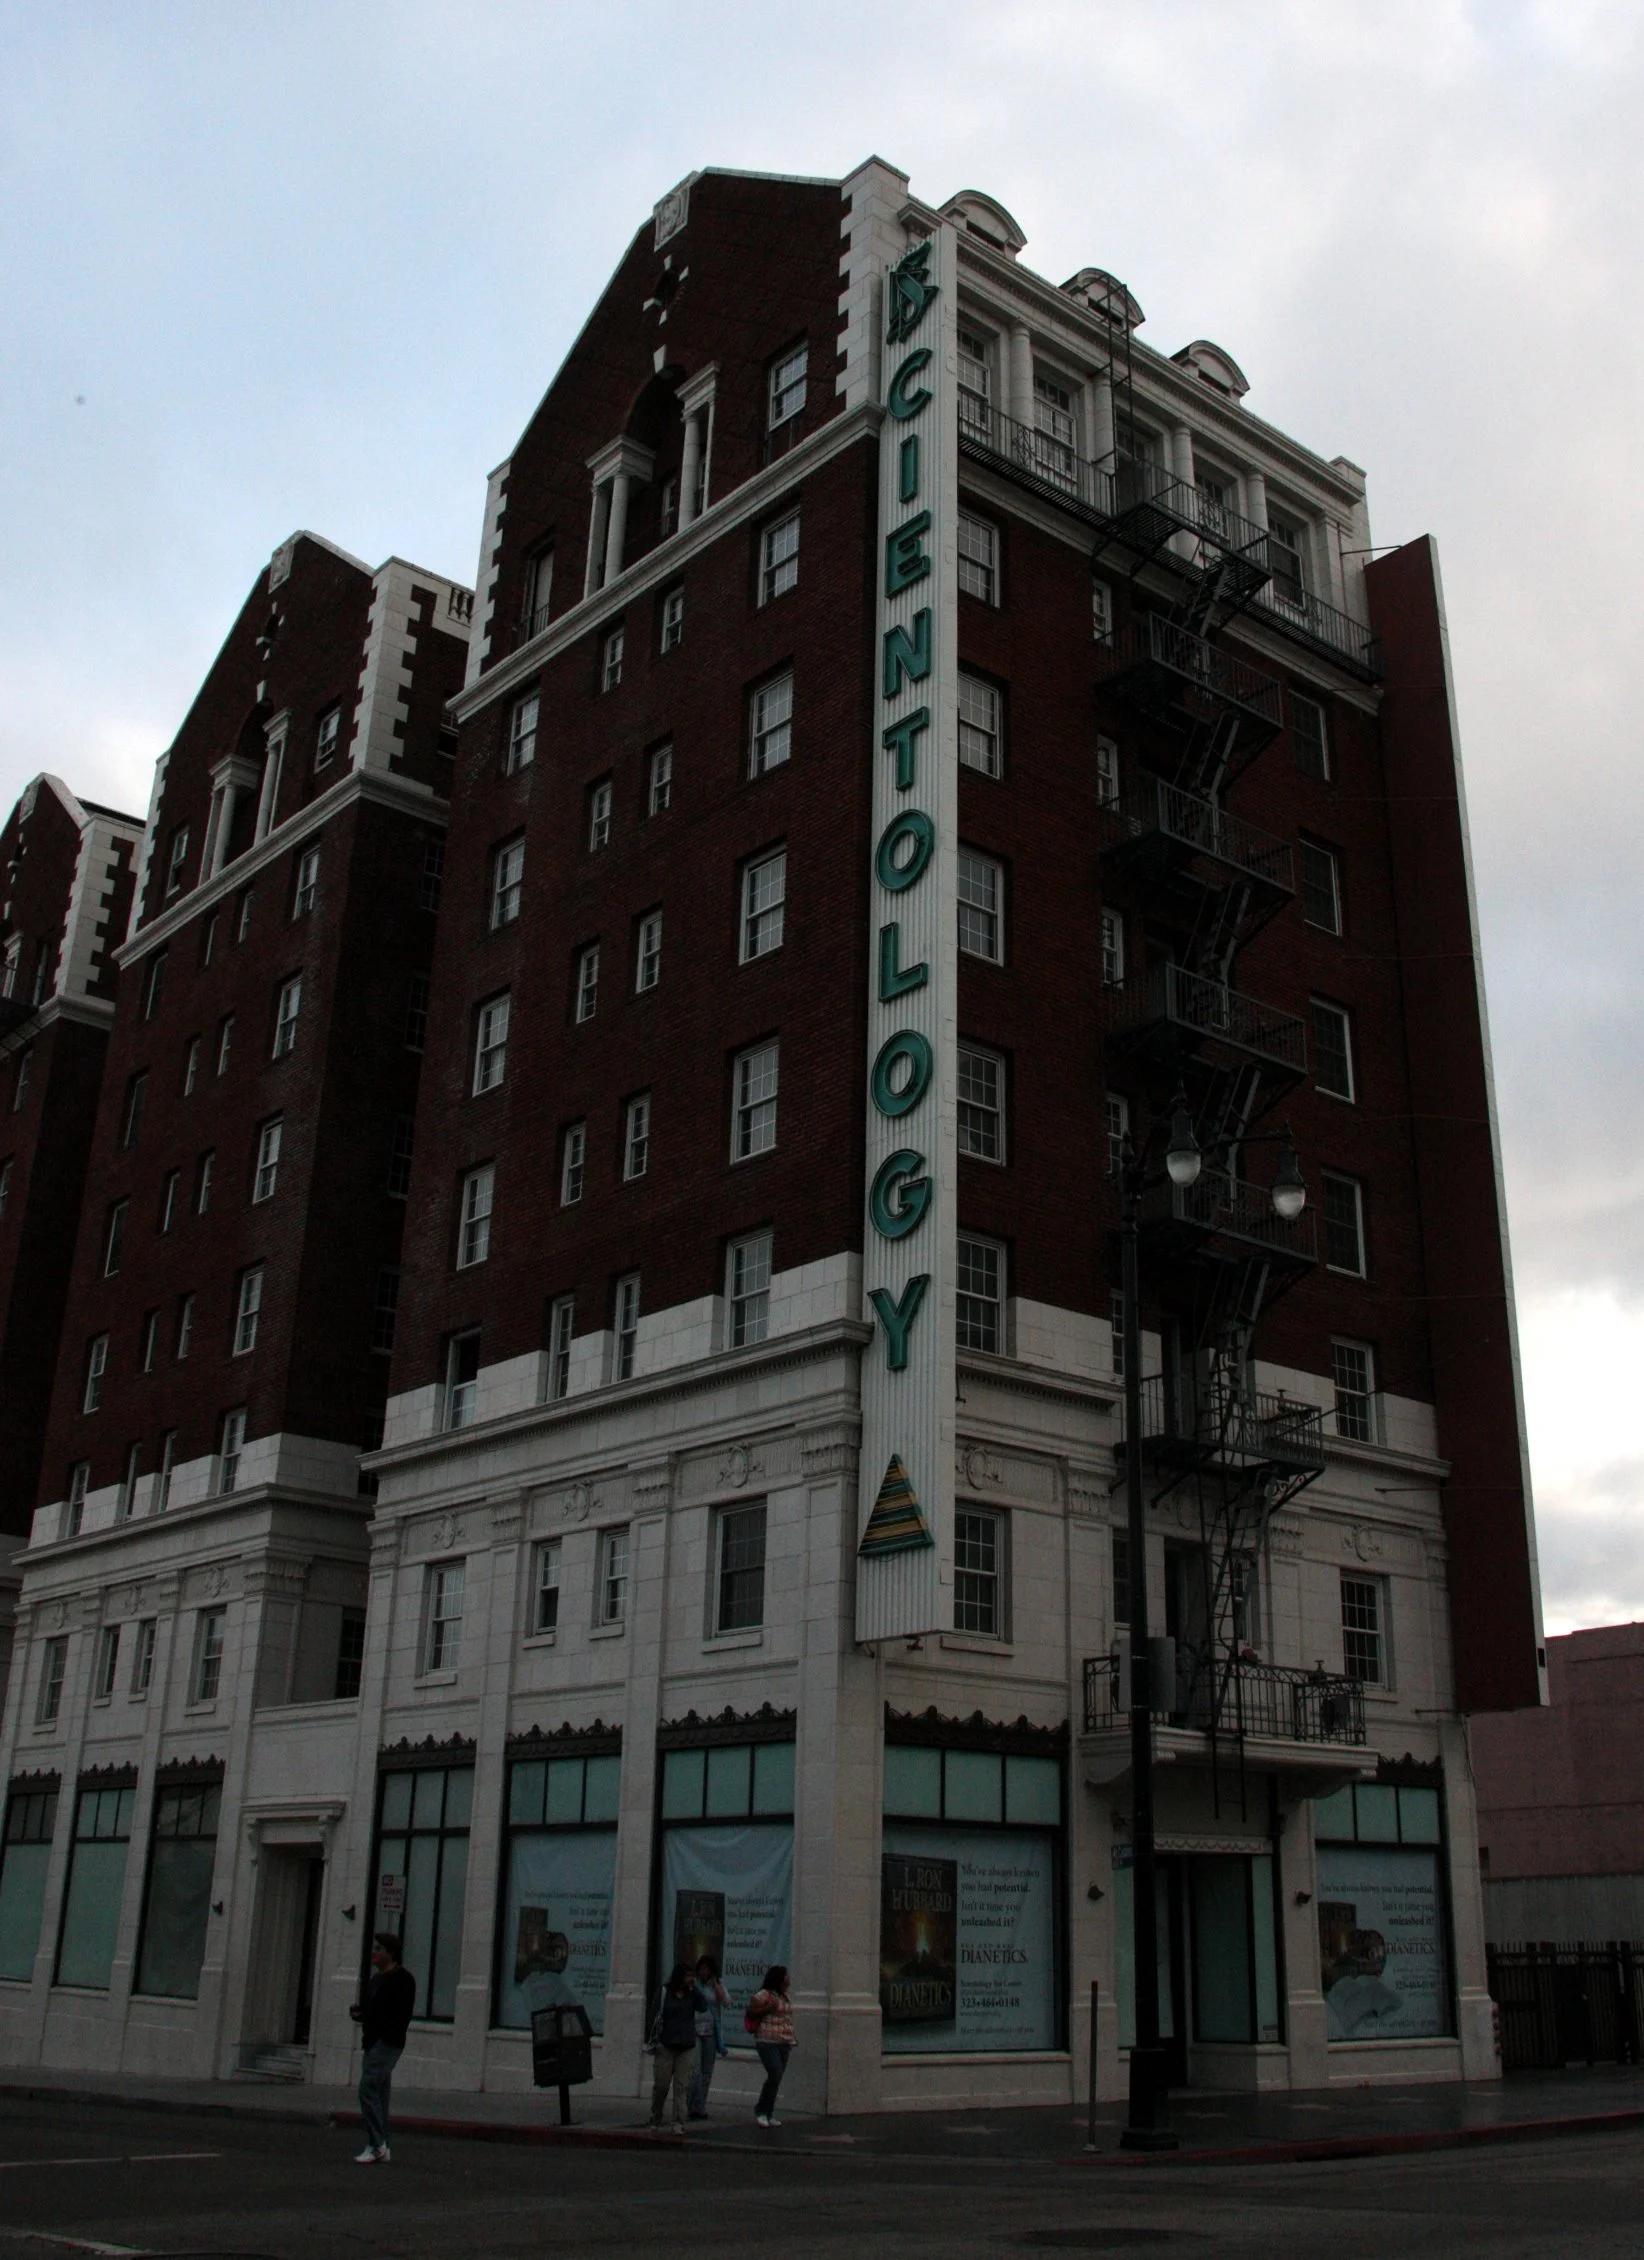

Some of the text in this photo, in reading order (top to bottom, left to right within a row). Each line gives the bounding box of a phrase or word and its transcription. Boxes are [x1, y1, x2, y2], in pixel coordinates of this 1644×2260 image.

[916, 1867, 944, 1890] RON
[892, 1888, 952, 1912] HUBBARD
[889, 1980, 952, 2010] DIANETICS
